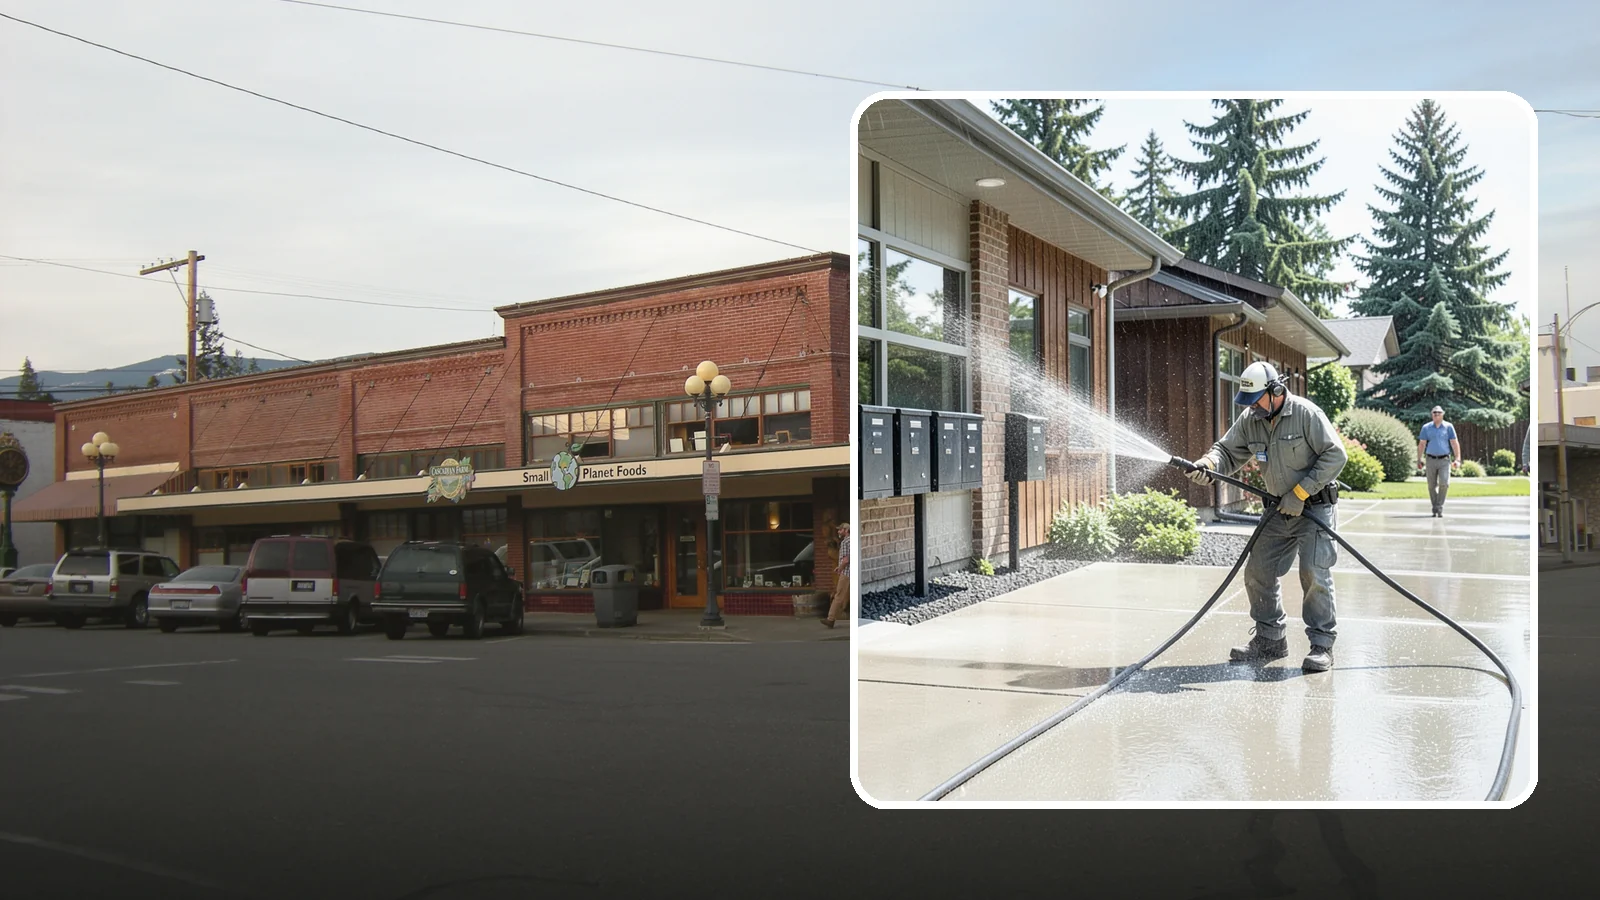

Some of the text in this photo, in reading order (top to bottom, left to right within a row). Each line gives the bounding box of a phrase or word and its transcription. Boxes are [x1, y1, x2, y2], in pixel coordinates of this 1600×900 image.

[523, 464, 647, 483] Small Planet Foods
